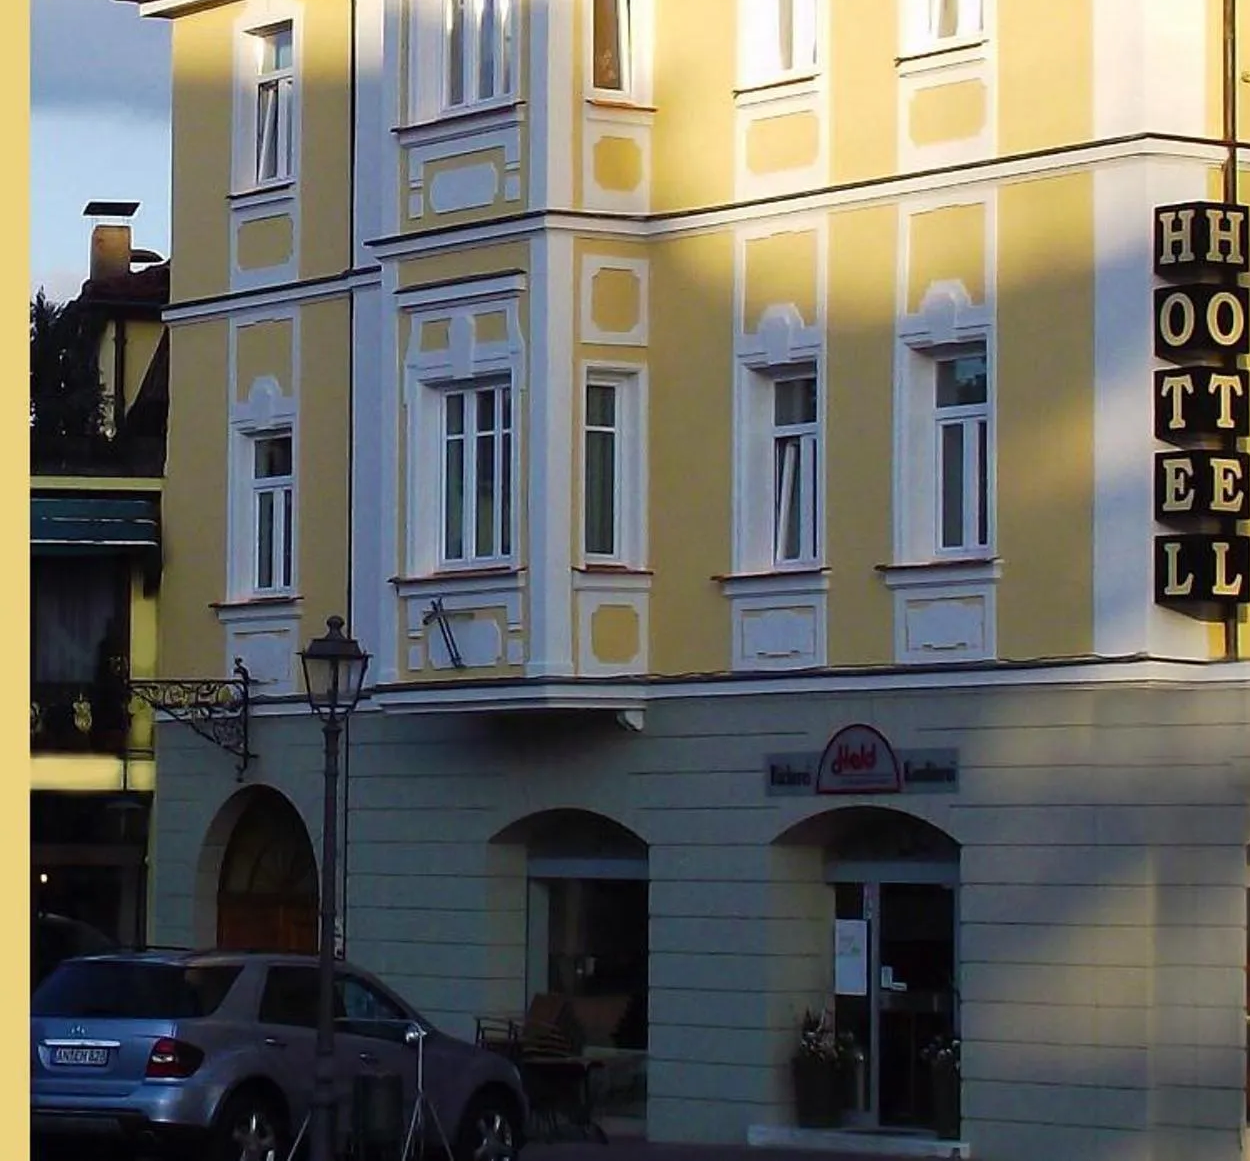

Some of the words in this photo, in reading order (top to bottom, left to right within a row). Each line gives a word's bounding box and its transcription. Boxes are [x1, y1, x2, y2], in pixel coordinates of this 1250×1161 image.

[1159, 209, 1196, 596] HOTEL
[1205, 209, 1244, 596] HOTEL
[831, 742, 877, 775] Held
